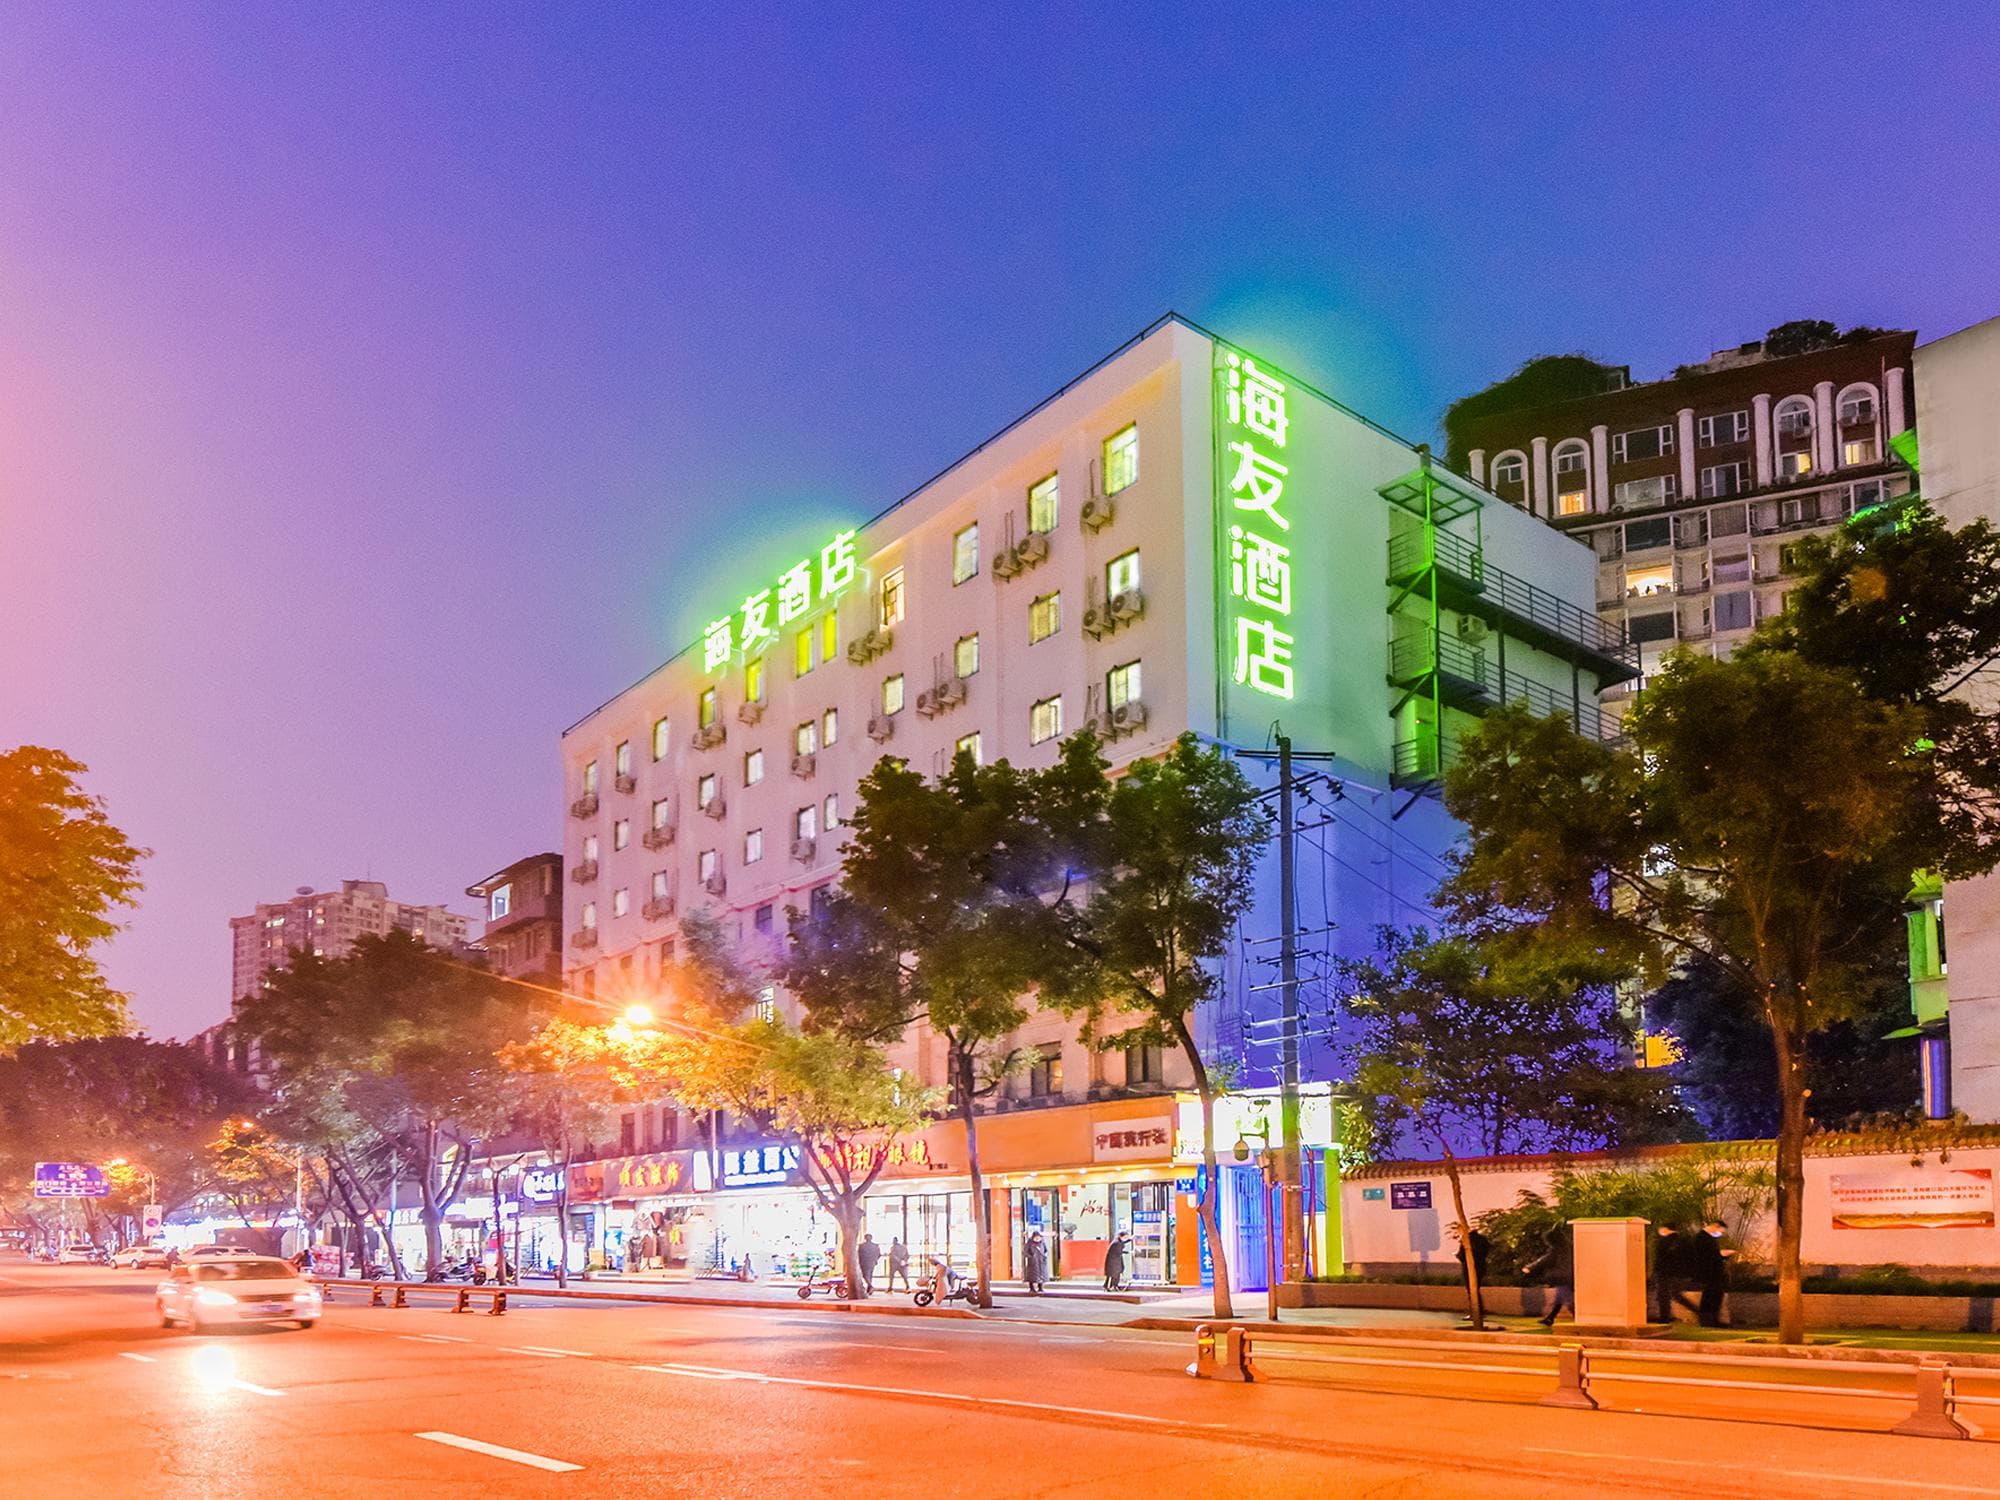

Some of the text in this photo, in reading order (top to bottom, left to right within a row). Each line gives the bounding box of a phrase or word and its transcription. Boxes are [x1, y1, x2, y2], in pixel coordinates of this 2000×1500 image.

[704, 529, 856, 673] 海友酒店
[1227, 352, 1294, 700] 海友酒店
